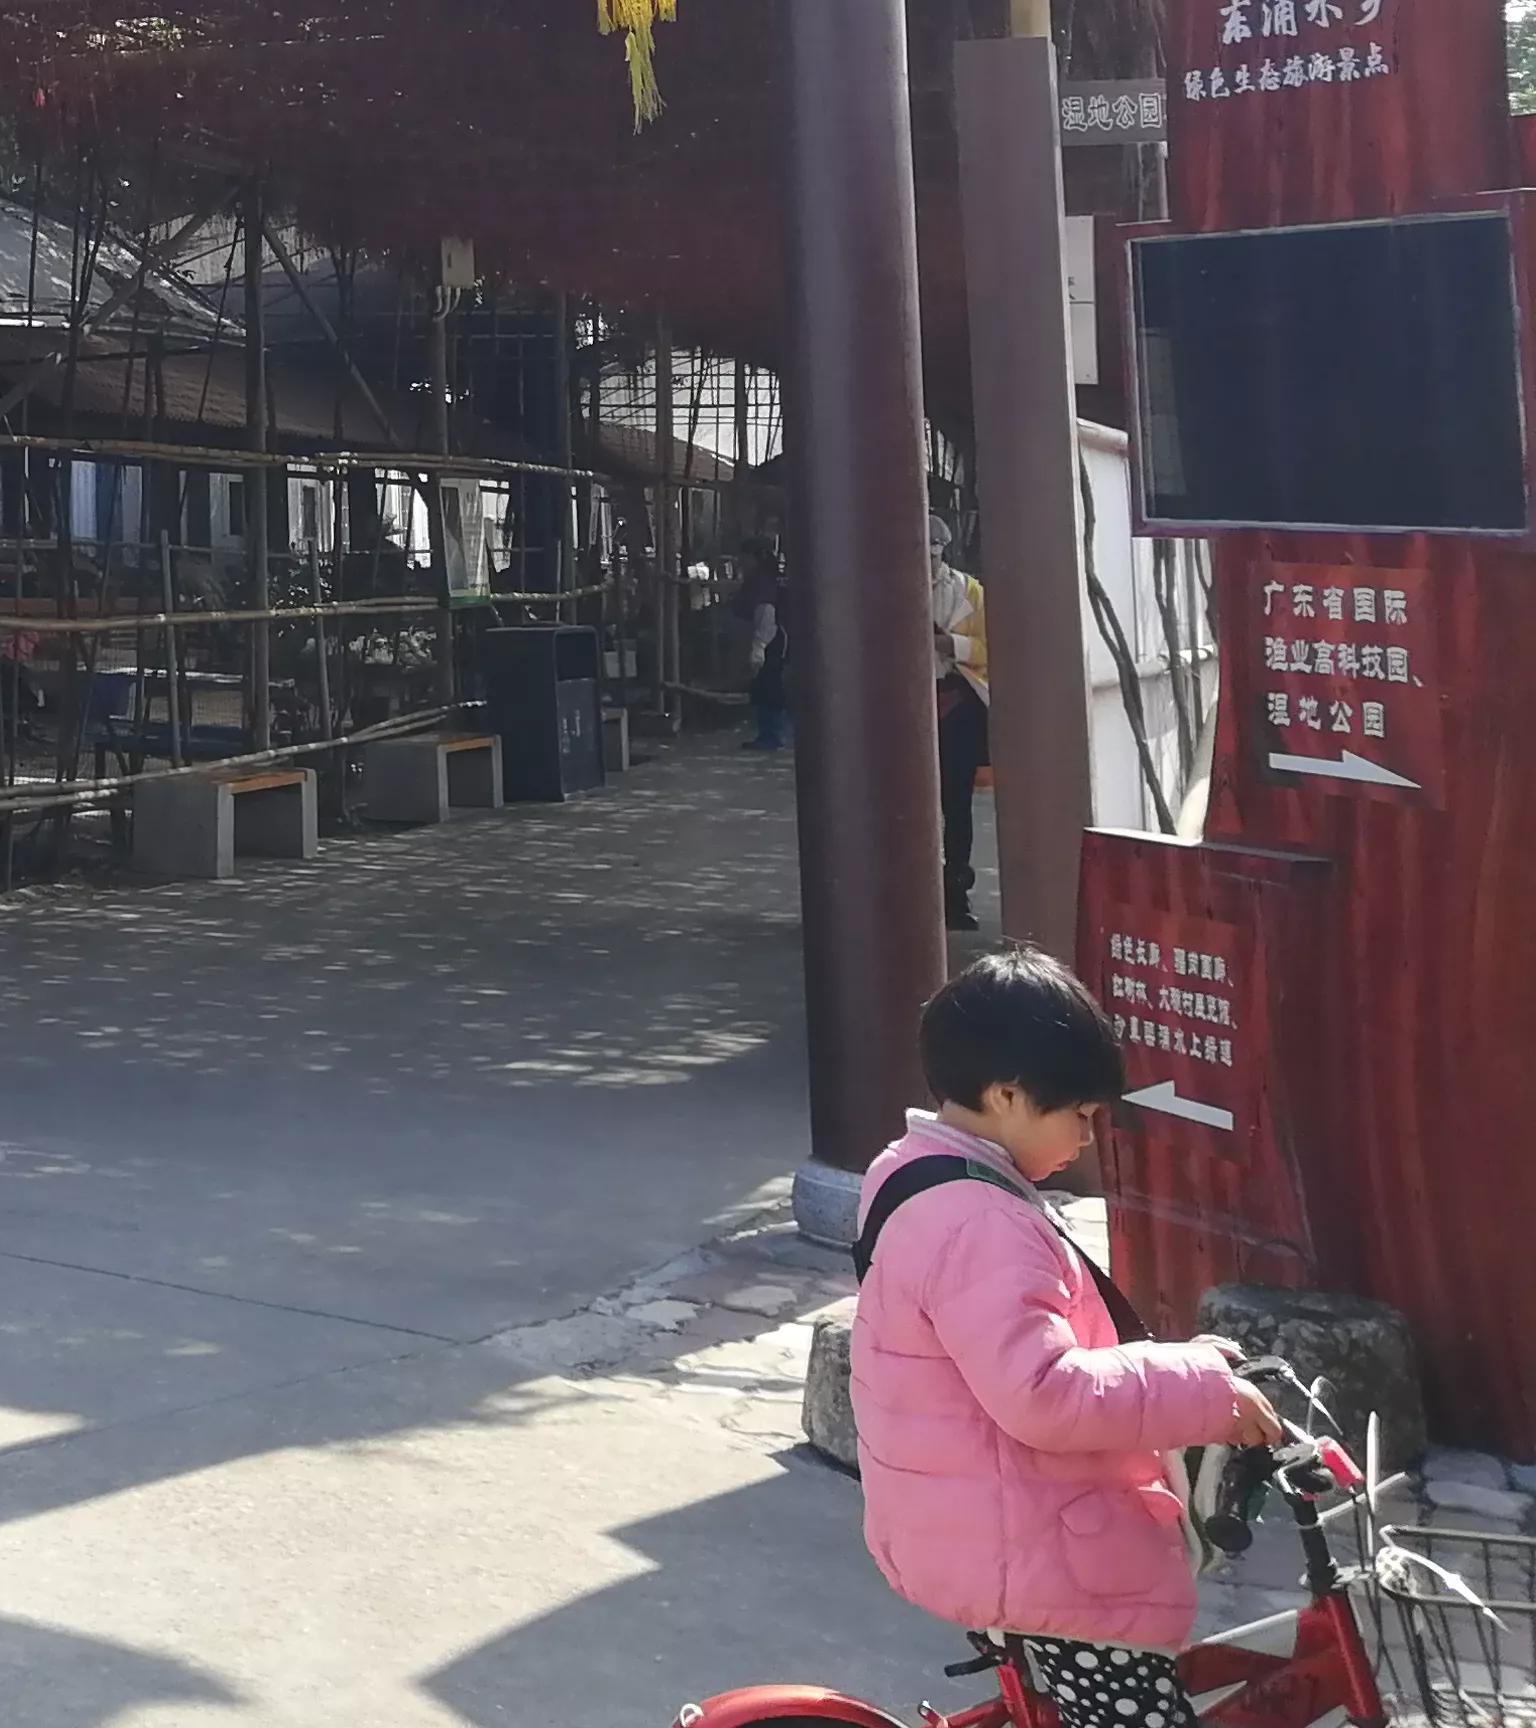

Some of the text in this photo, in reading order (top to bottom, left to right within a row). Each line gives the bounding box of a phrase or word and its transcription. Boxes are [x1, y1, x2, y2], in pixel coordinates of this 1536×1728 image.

[1184, 41, 1391, 102] 绿色生态旅游景点
[1263, 580, 1409, 626] 广东省国际
[1268, 692, 1386, 739] 湿地公园
